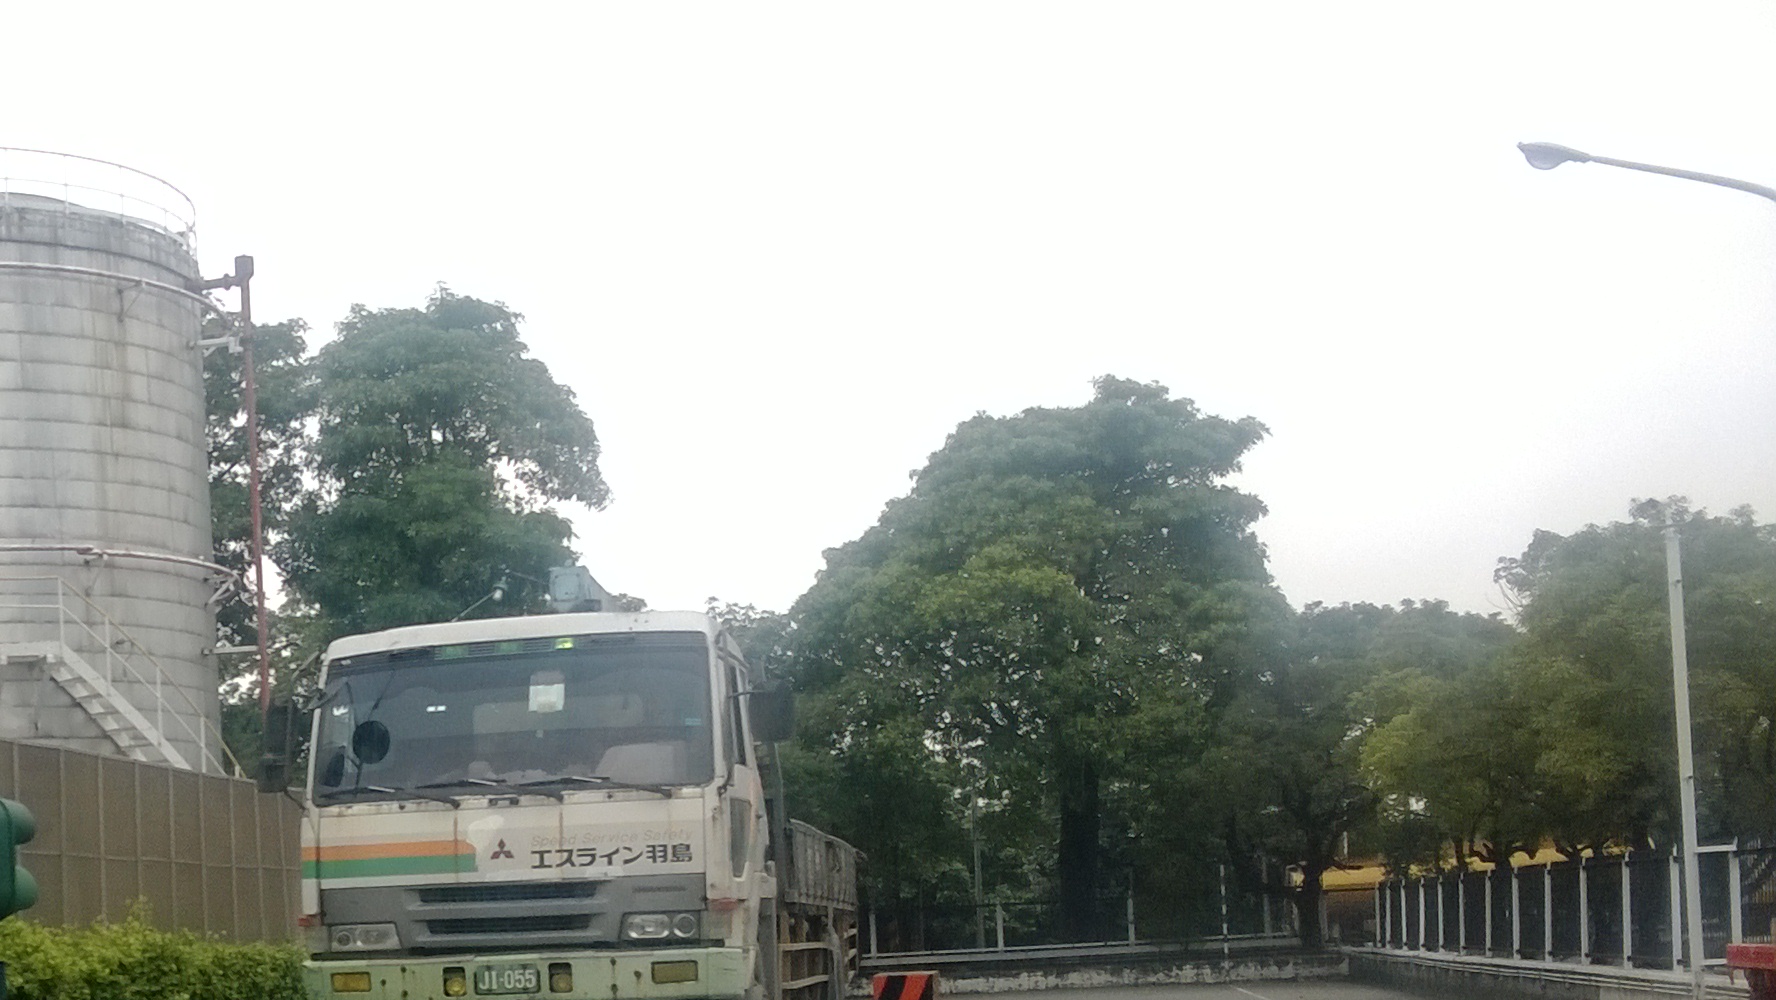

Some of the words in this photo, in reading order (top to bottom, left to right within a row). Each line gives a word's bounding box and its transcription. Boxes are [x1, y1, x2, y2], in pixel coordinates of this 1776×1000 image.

[531, 834, 577, 849] Speed
[582, 831, 639, 845] Service
[644, 828, 693, 841] Safety
[530, 843, 693, 869] エスライン羽島
[479, 969, 537, 990] JI-055
